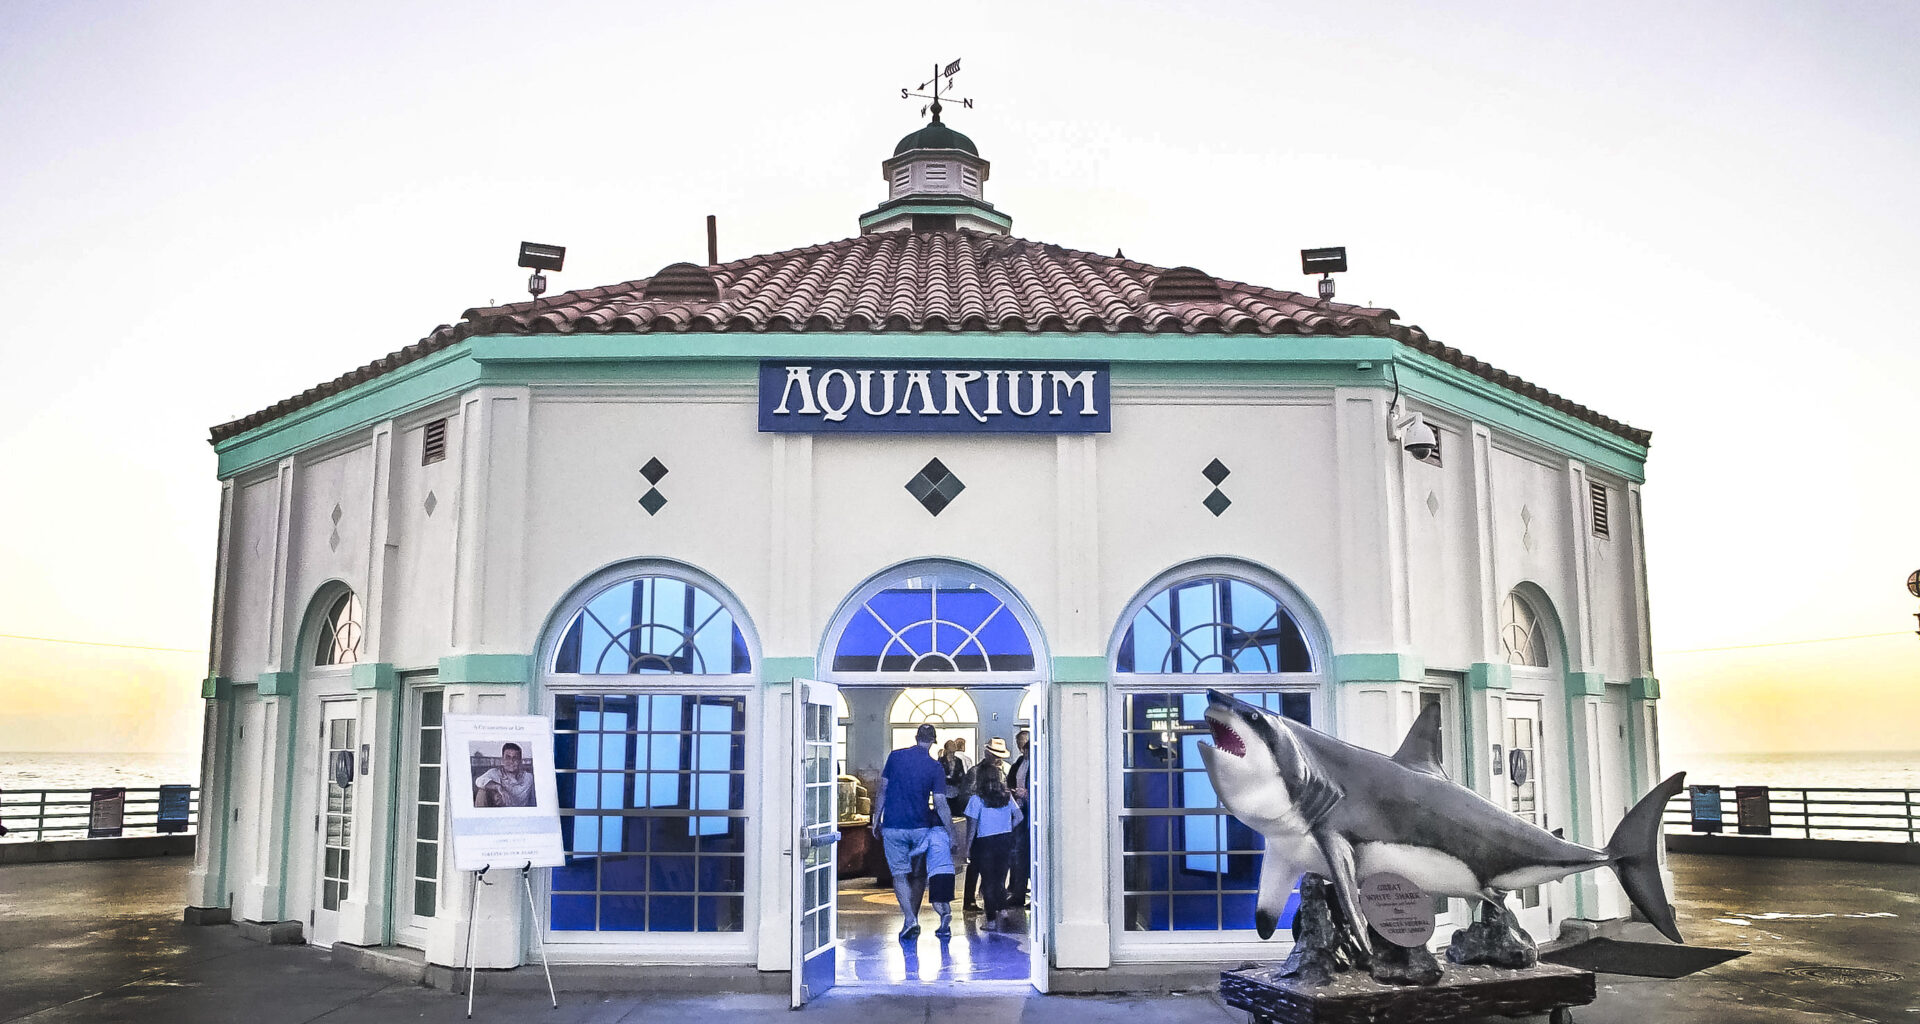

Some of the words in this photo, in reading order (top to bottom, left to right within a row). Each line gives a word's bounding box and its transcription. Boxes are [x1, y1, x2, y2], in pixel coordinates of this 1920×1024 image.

[901, 88, 909, 99] S
[963, 97, 973, 109] N
[772, 366, 1099, 422] AQUARIUM
[1376, 883, 1401, 892] GREAT
[1365, 893, 1391, 901] WHITE
[1394, 892, 1420, 900] SHARK
